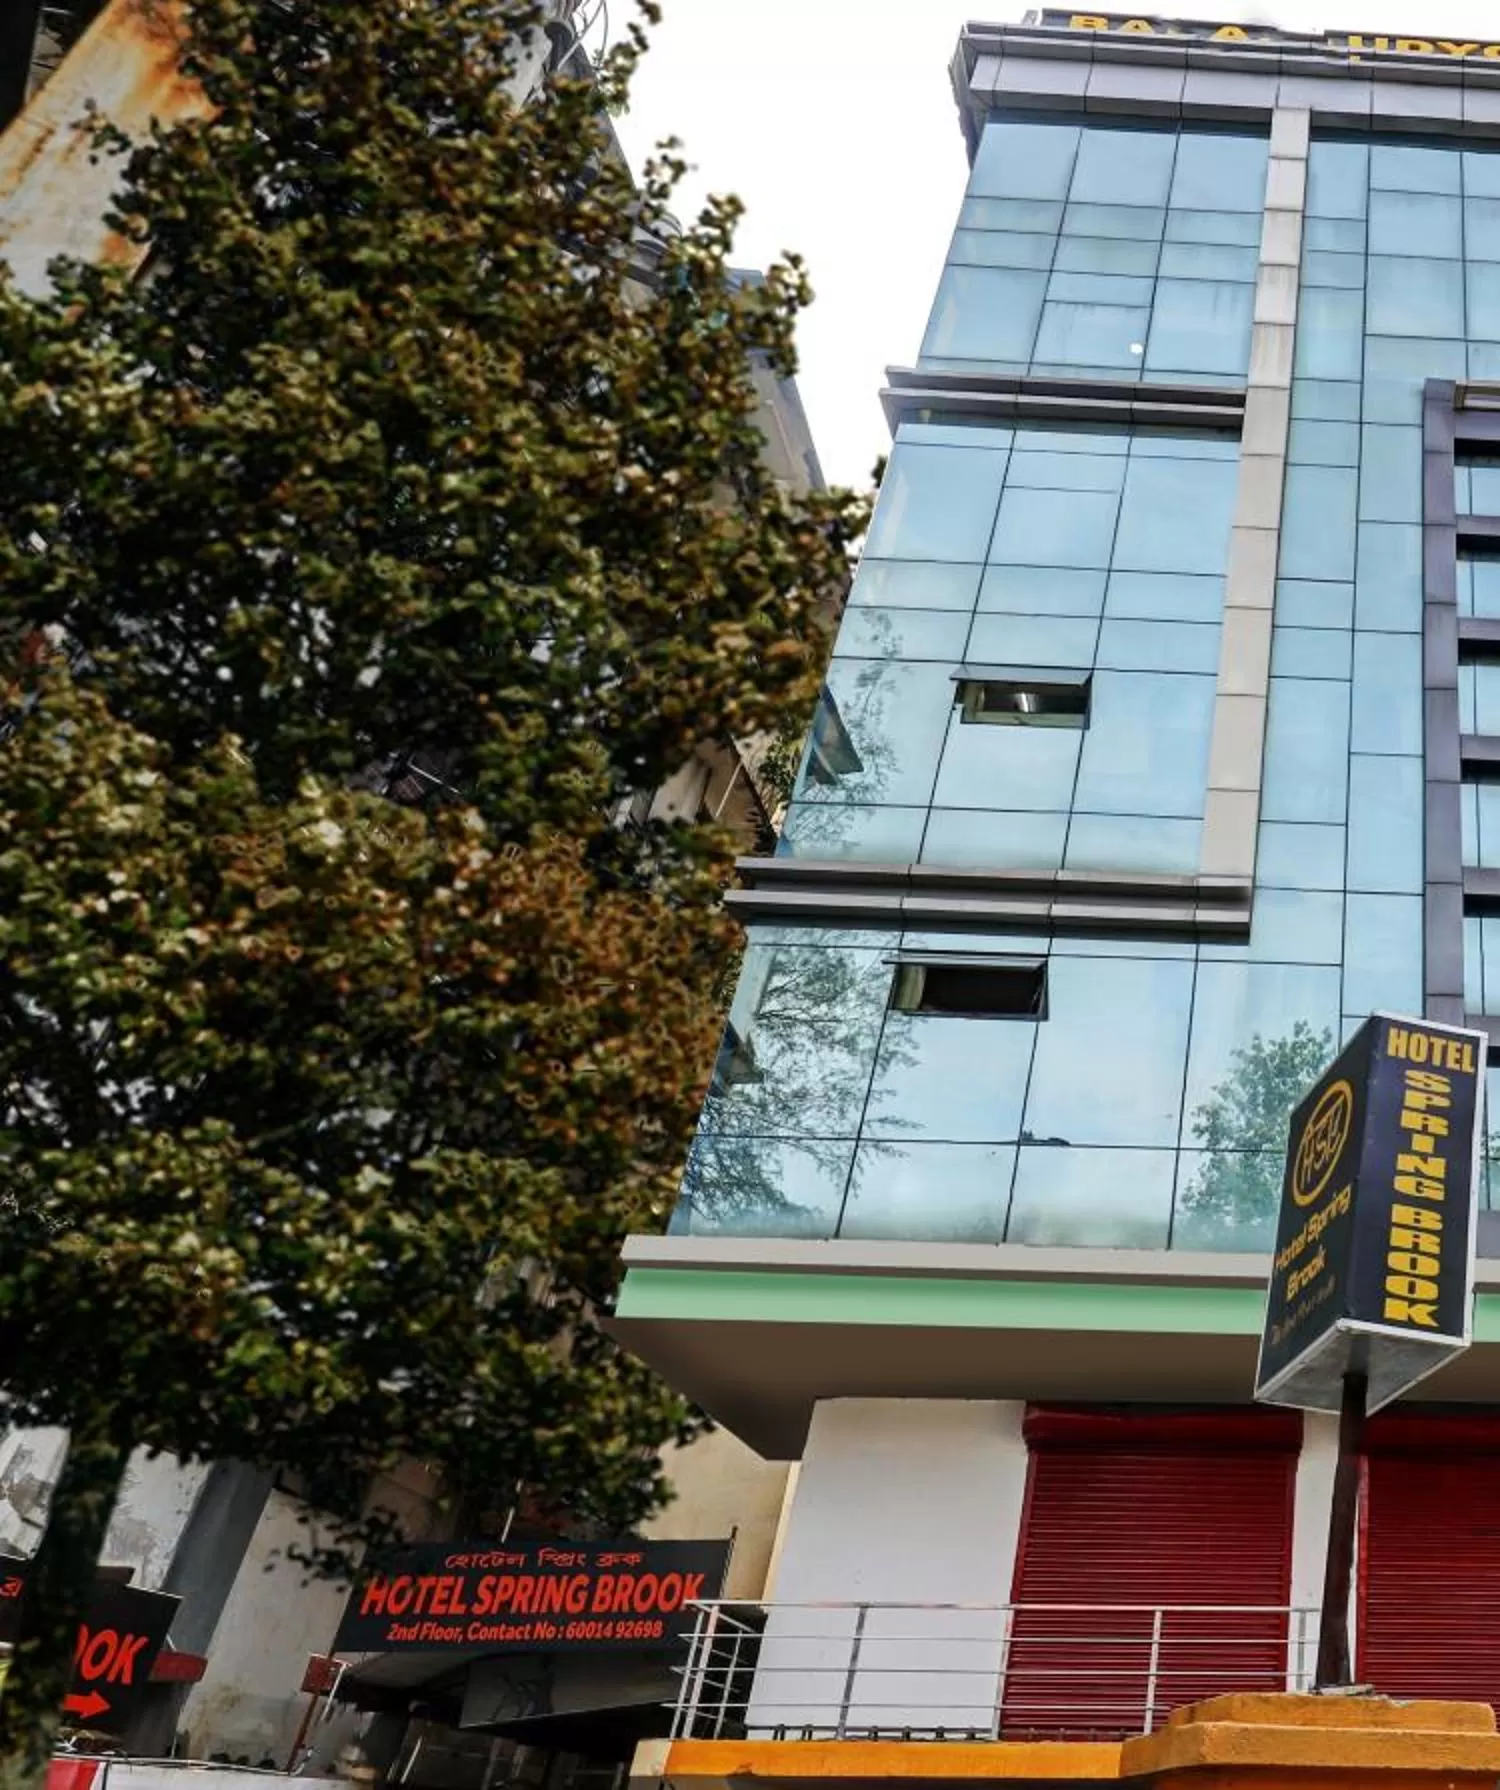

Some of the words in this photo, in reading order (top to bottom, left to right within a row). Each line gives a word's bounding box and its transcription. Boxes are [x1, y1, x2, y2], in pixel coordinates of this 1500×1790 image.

[1387, 1027, 1476, 1074] HOTEL
[1393, 1069, 1452, 1201] SPRING
[1307, 1184, 1352, 1243] Spring
[1287, 1244, 1326, 1301] Brook
[1384, 1203, 1444, 1328] BROOK
[360, 1574, 466, 1616] HOTEL
[472, 1573, 590, 1615] SPRING
[591, 1572, 705, 1613] BROOK
[386, 1622, 419, 1641] 2nd
[420, 1621, 462, 1643] Floor,
[468, 1621, 531, 1641] Contact
